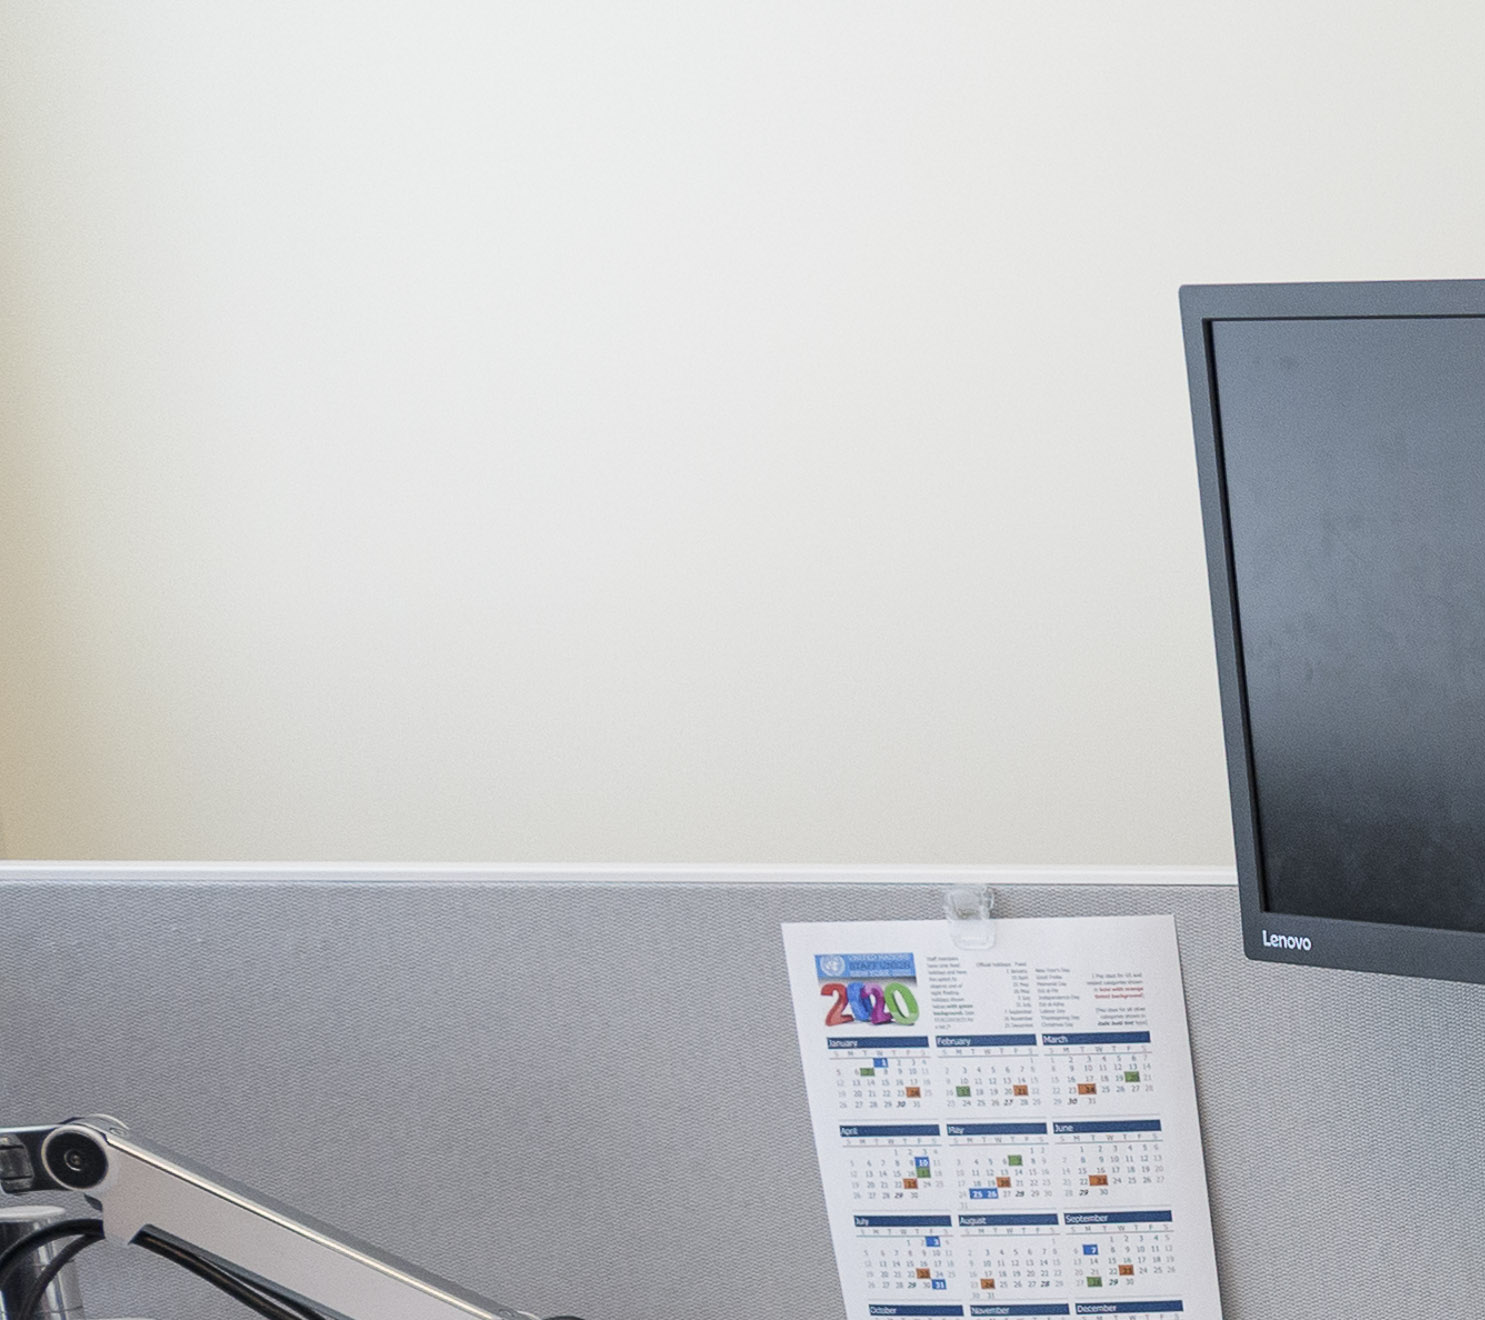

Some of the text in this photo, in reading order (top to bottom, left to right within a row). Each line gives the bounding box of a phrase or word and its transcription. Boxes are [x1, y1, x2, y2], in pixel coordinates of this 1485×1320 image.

[1262, 930, 1312, 951] Lenovo
[820, 981, 920, 1027] 2020
[828, 1038, 858, 1049] January
[937, 1036, 971, 1047] February
[1043, 1034, 1068, 1044] March
[840, 1126, 858, 1137] April
[948, 1125, 964, 1136] May
[1055, 1123, 1074, 1132] June
[855, 1217, 869, 1228] July
[960, 1216, 986, 1227] August
[1065, 1213, 1108, 1224] September
[870, 1305, 897, 1315] October
[971, 1305, 1010, 1315] November
[1077, 1303, 1117, 1313] December
